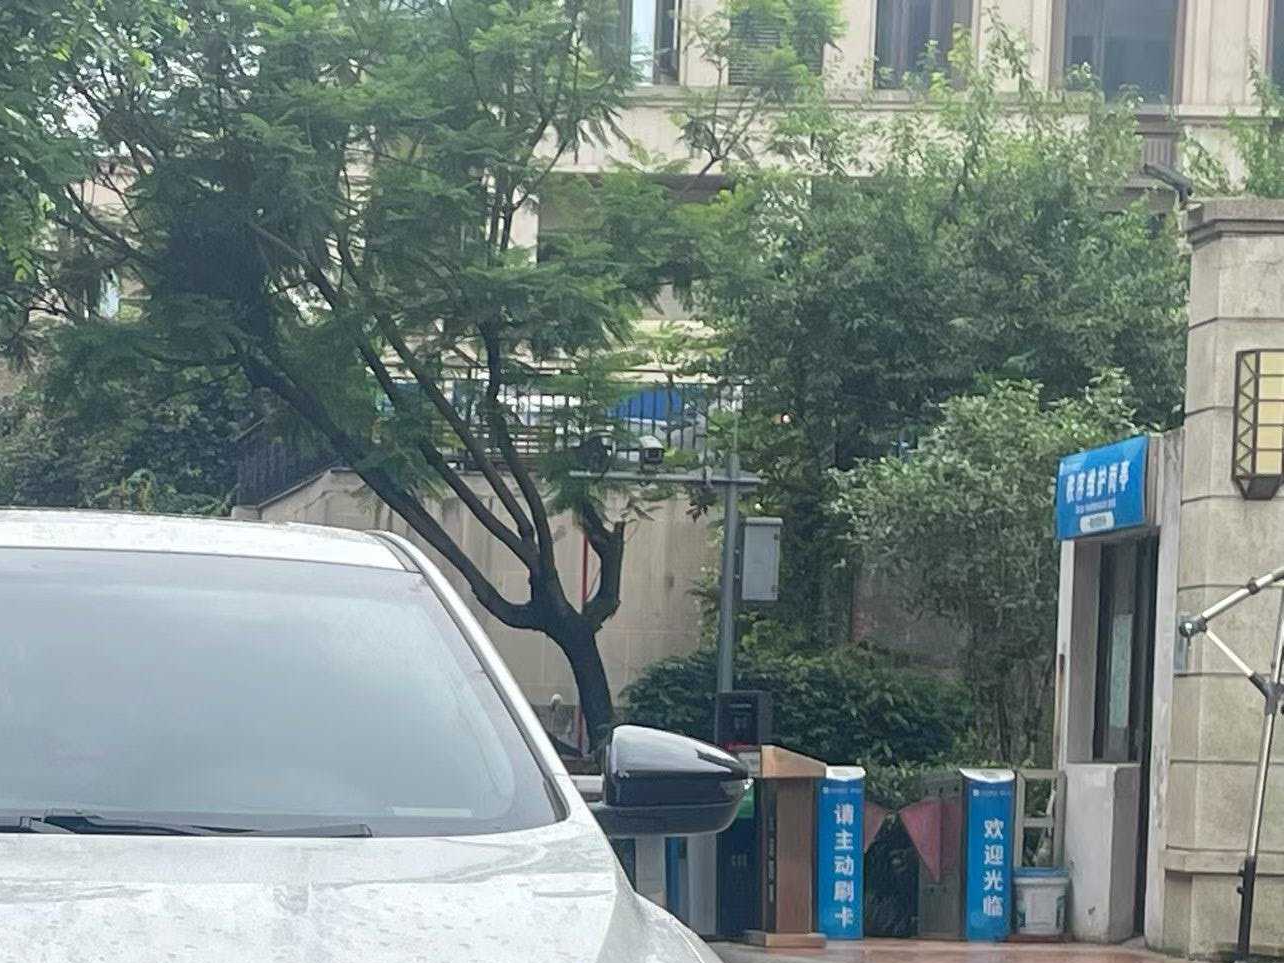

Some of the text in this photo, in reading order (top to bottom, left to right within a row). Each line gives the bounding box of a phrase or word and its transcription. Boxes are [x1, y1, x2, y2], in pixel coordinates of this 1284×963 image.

[834, 803, 854, 928] 请主动刷卡
[983, 818, 1004, 916] 欢迎光临
